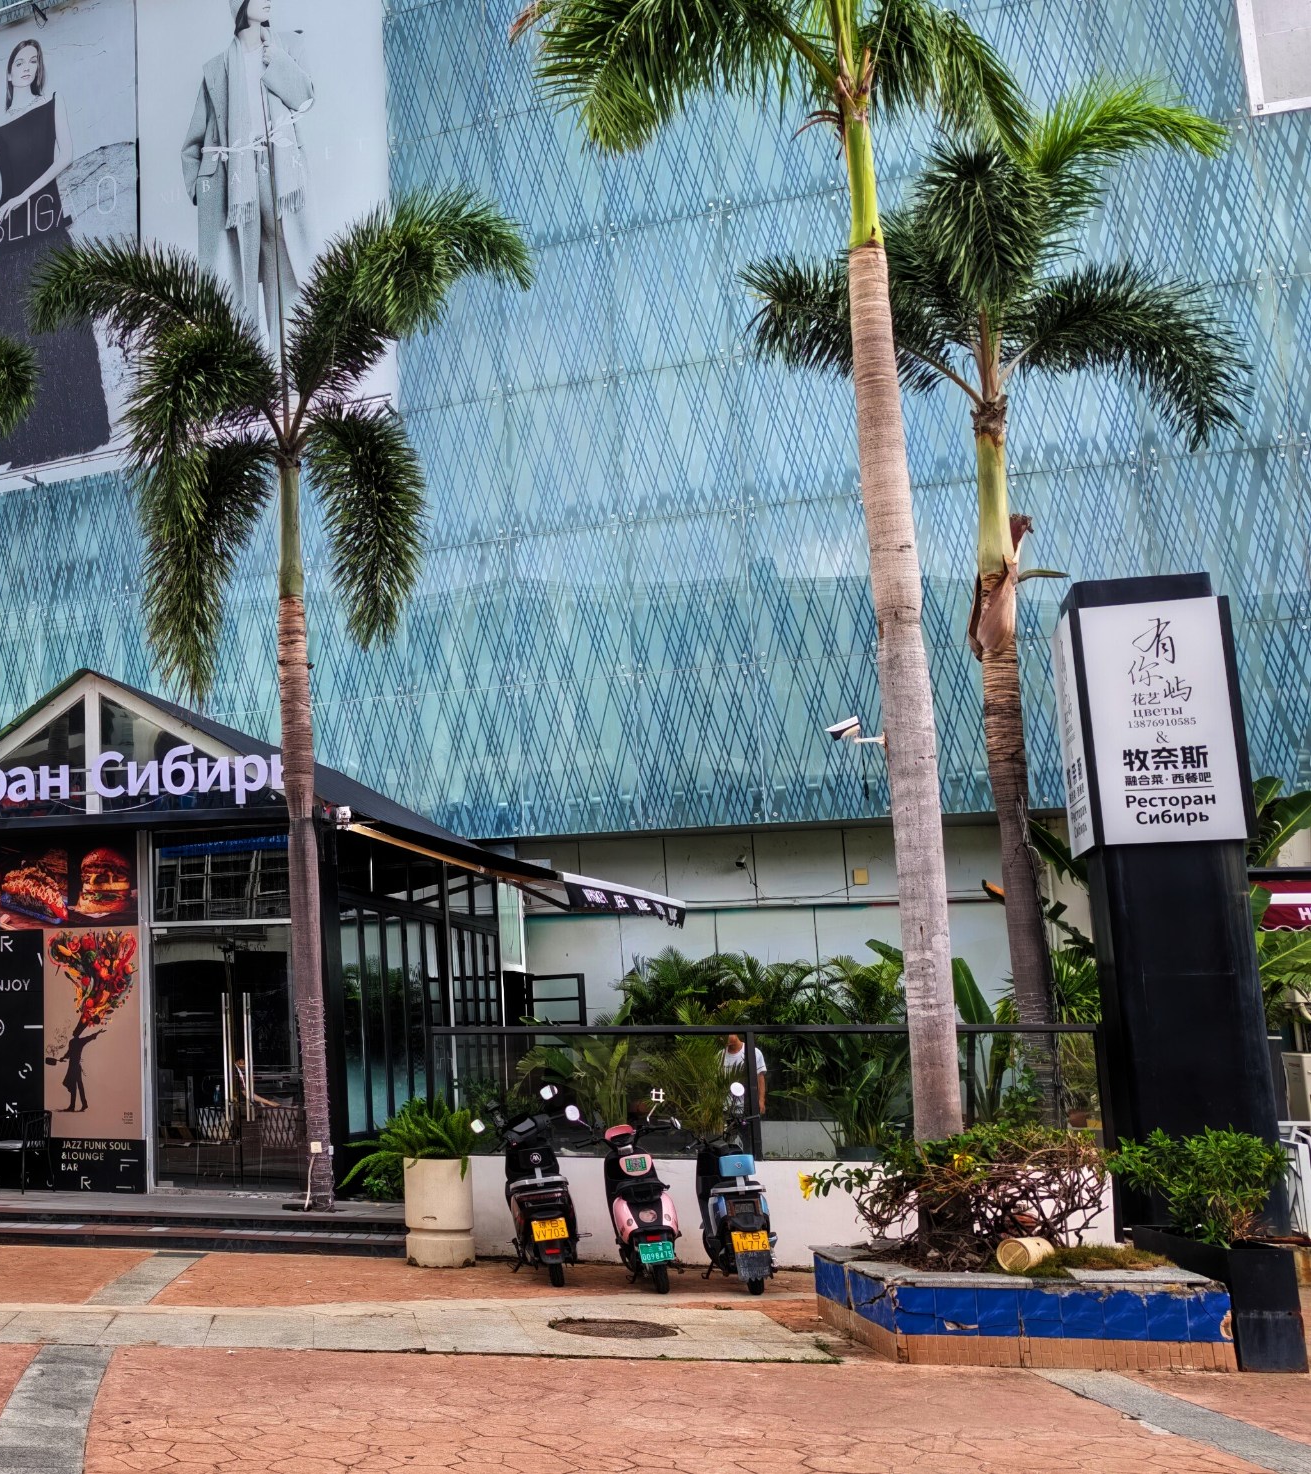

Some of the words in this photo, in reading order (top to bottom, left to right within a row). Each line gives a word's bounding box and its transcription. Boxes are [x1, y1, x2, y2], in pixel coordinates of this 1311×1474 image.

[1131, 692, 1160, 706] 花艺
[1128, 717, 1197, 729] 13876910585
[1156, 731, 1170, 743] &
[1122, 745, 1209, 772] 牧奈斯
[1125, 794, 1216, 809] Ресторан
[1136, 809, 1209, 826] Сибирь
[62, 1141, 82, 1149] JAZZ
[84, 1141, 107, 1150] FUNK
[109, 1141, 132, 1151] SOUL
[61, 1151, 105, 1160] &LOUNGE
[61, 1163, 79, 1171] BAR
